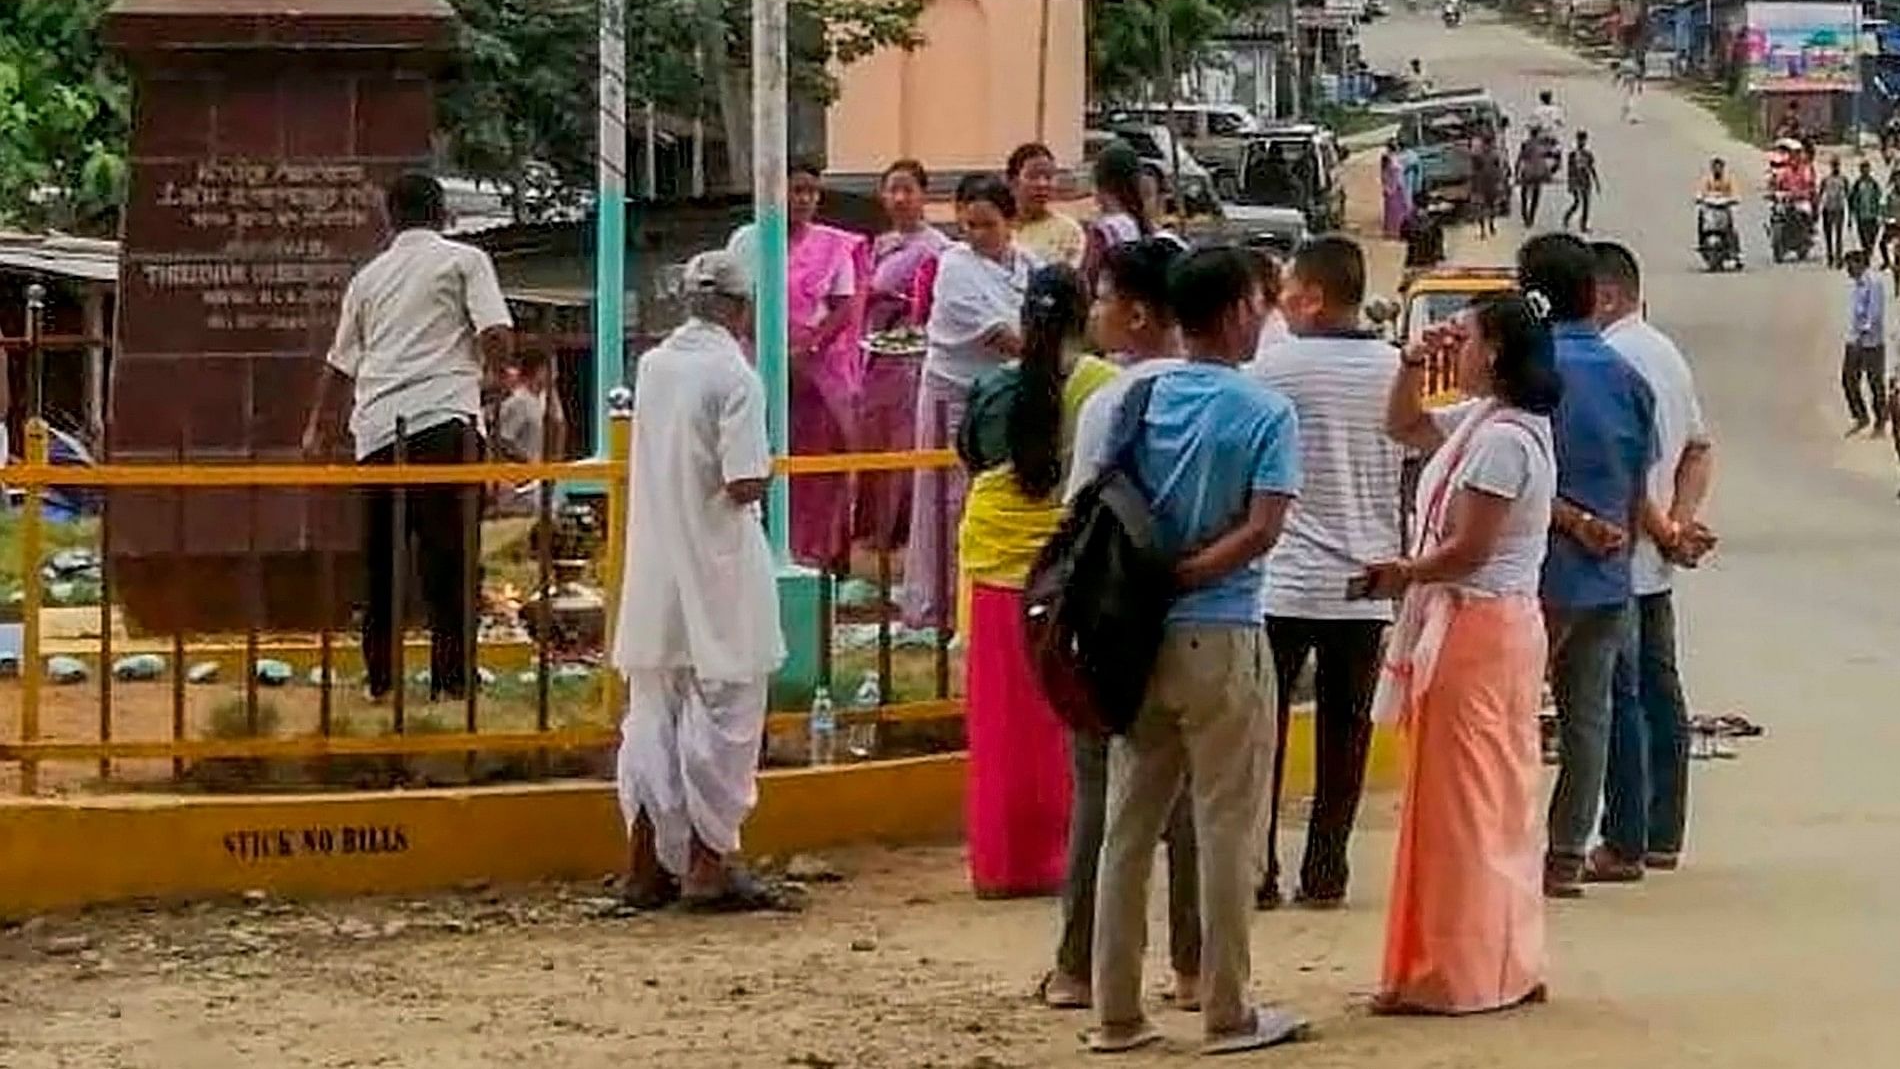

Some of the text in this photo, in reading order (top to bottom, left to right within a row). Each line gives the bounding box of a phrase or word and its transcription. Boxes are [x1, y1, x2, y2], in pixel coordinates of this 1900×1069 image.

[223, 826, 411, 858] STICK NO BILLS
